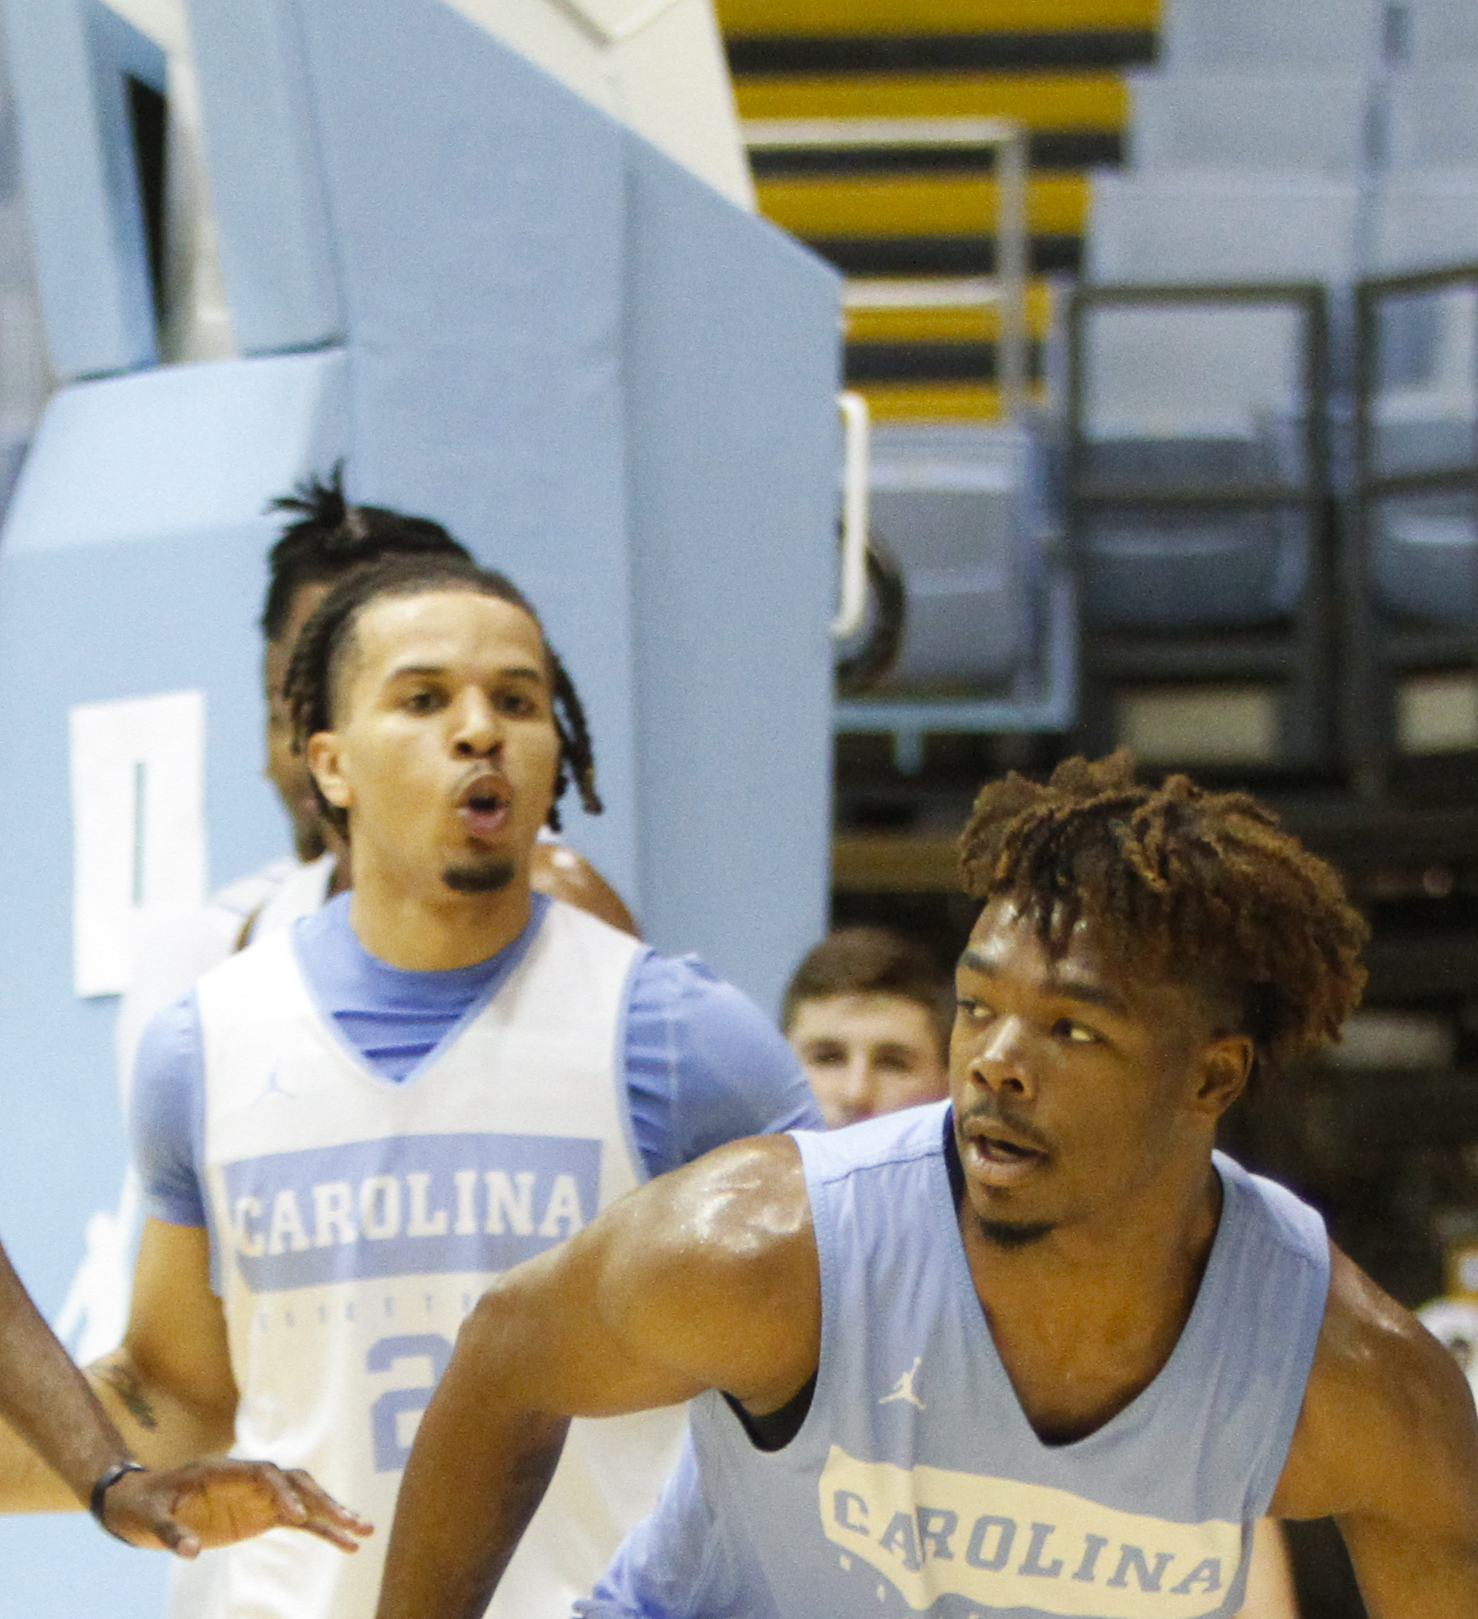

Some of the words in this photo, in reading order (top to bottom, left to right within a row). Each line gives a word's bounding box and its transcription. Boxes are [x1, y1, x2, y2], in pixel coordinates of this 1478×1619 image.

[233, 1169, 584, 1259] CAROLINA
[365, 1333, 454, 1473] 2
[832, 1489, 1223, 1595] CAROLINA
